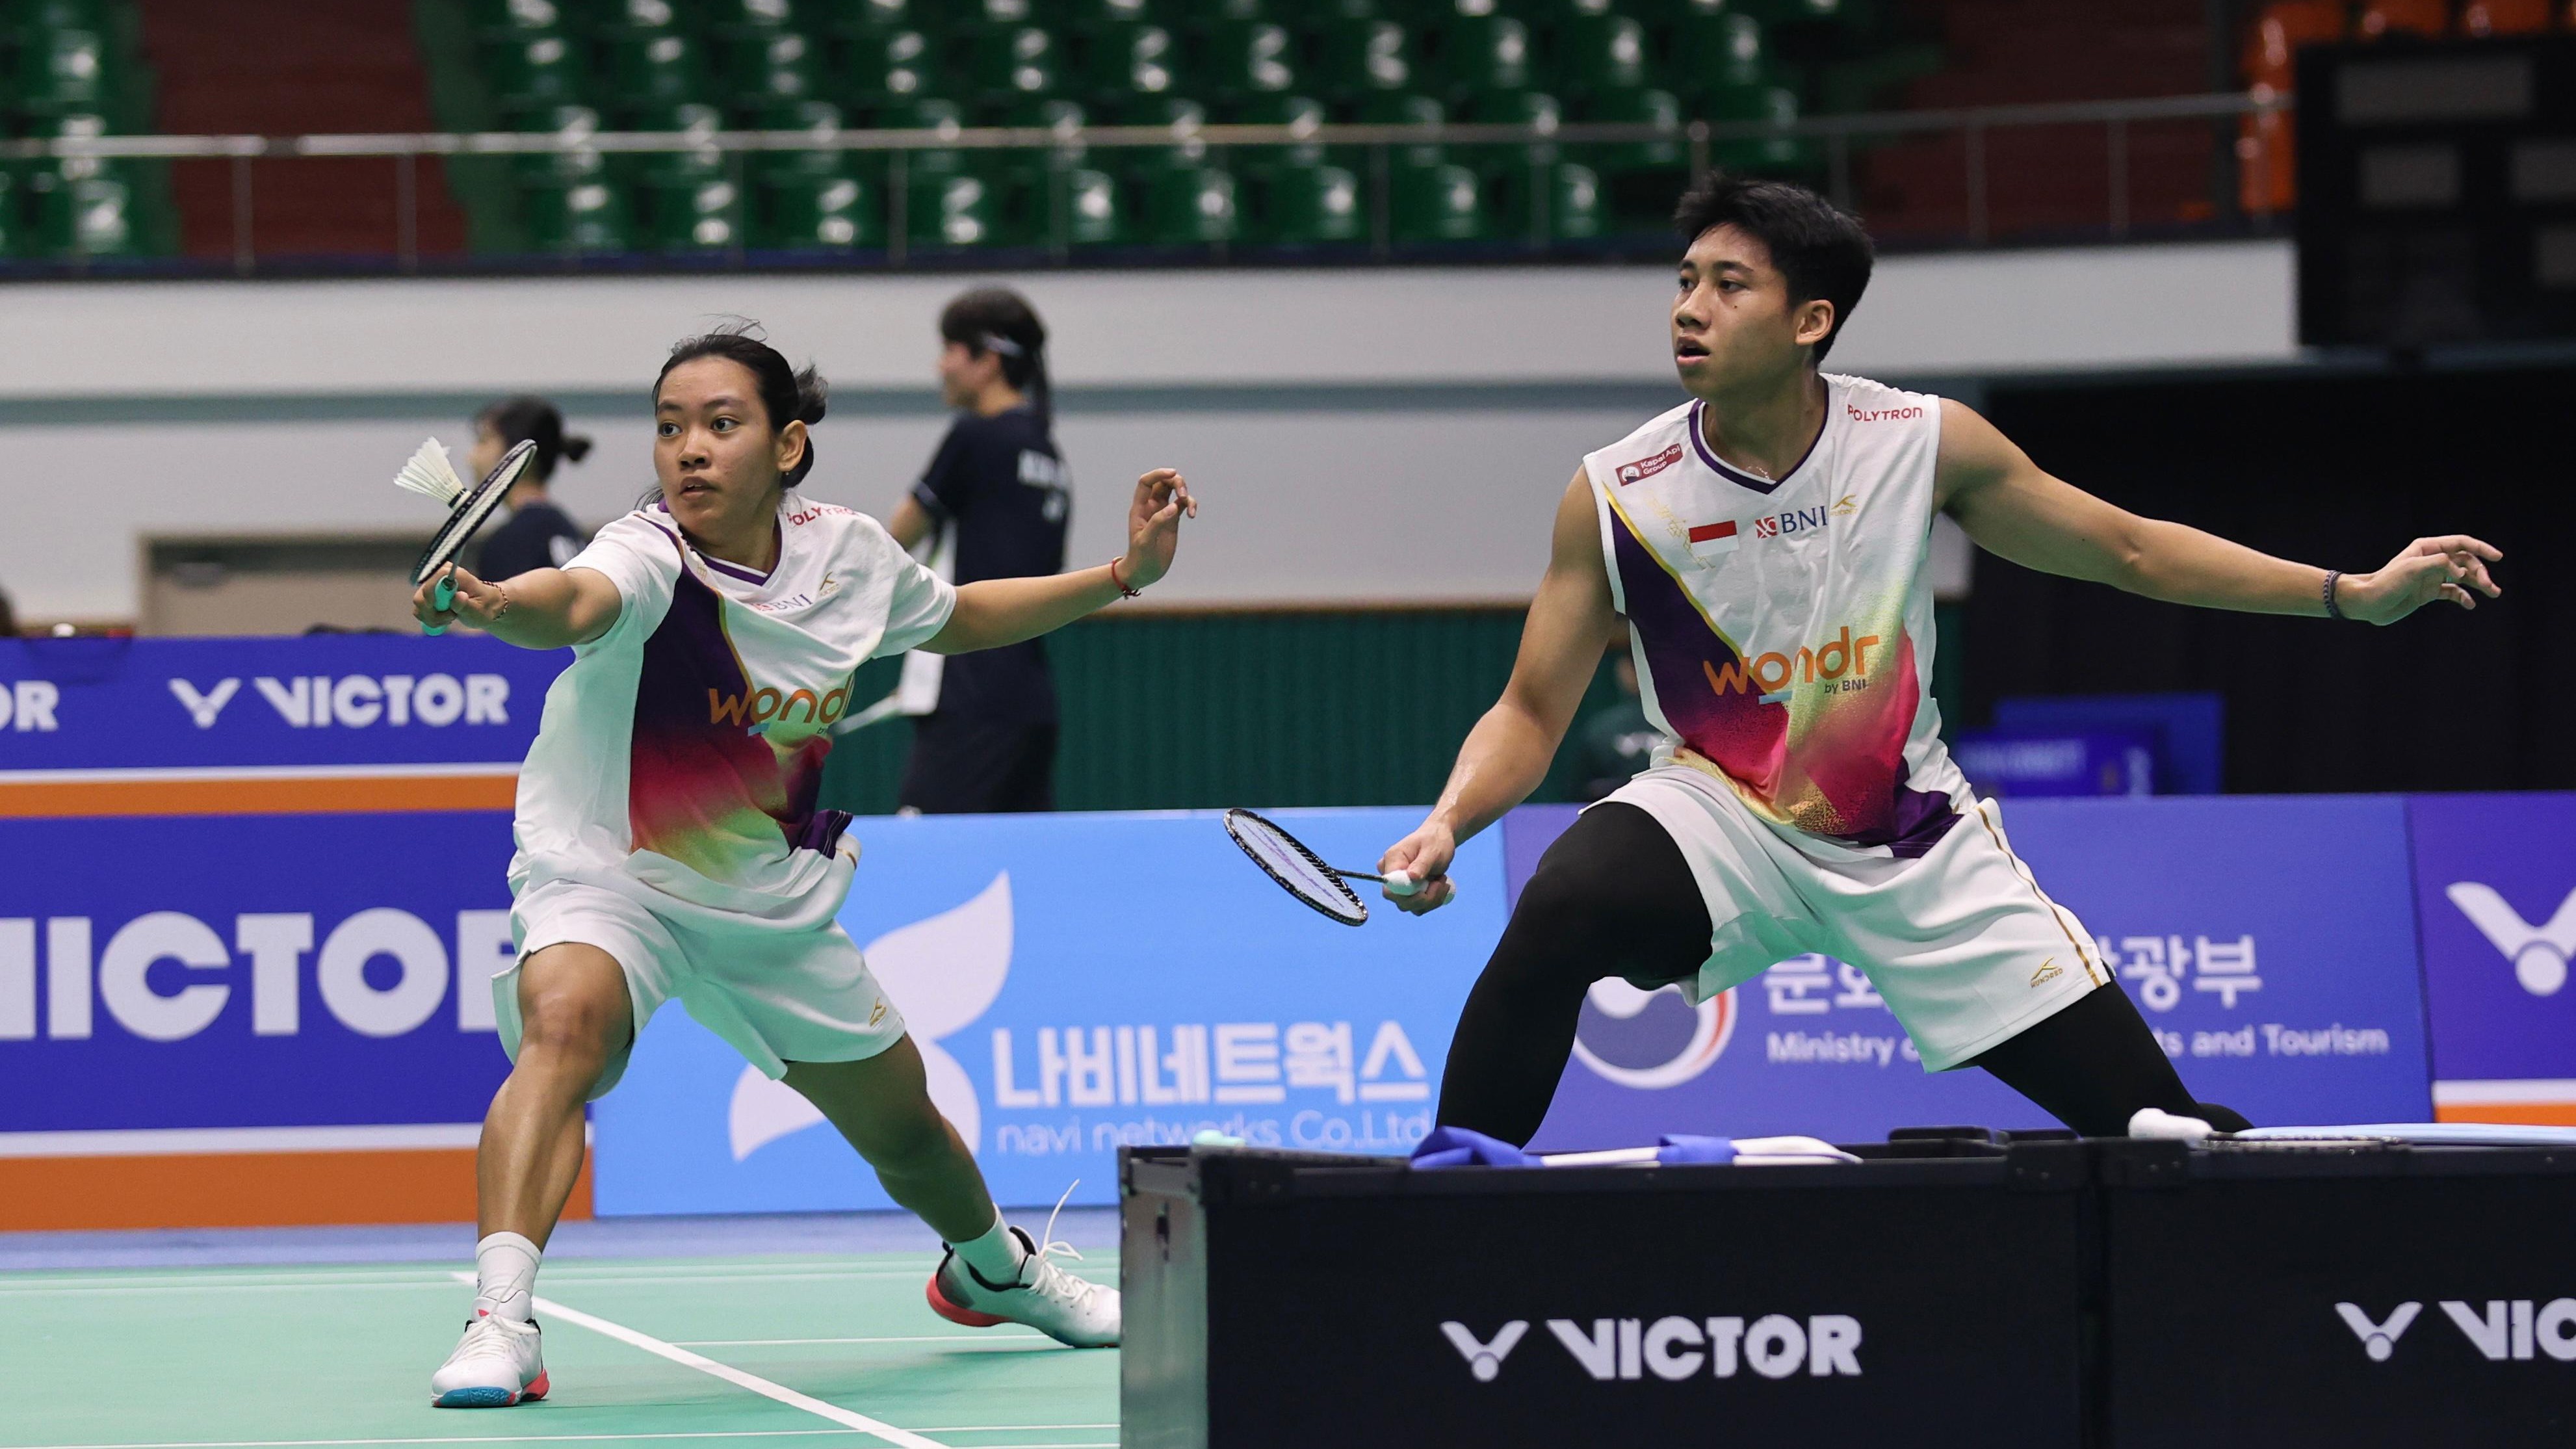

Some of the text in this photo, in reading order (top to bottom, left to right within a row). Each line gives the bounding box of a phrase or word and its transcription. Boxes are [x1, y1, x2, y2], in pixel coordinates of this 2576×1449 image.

[1847, 403, 1923, 422] POLYTRON
[1640, 445, 1680, 468] Kapal Api
[1643, 461, 1667, 475] Group
[1780, 506, 1828, 534] BNI
[770, 594, 813, 610] BNI
[1703, 625, 1879, 696] wondr
[0, 679, 59, 732] R
[254, 673, 510, 728] VICTOR
[1825, 679, 1866, 694] by BNI
[992, 1021, 1430, 1107] 나비네트웍스
[1766, 1030, 1896, 1068] Ministry
[2191, 1024, 2256, 1058] and
[2259, 1022, 2390, 1058] Tourism
[997, 1114, 1082, 1155] navi
[1545, 1312, 1863, 1381] VICTOR
[2438, 1297, 2576, 1361] VIC
